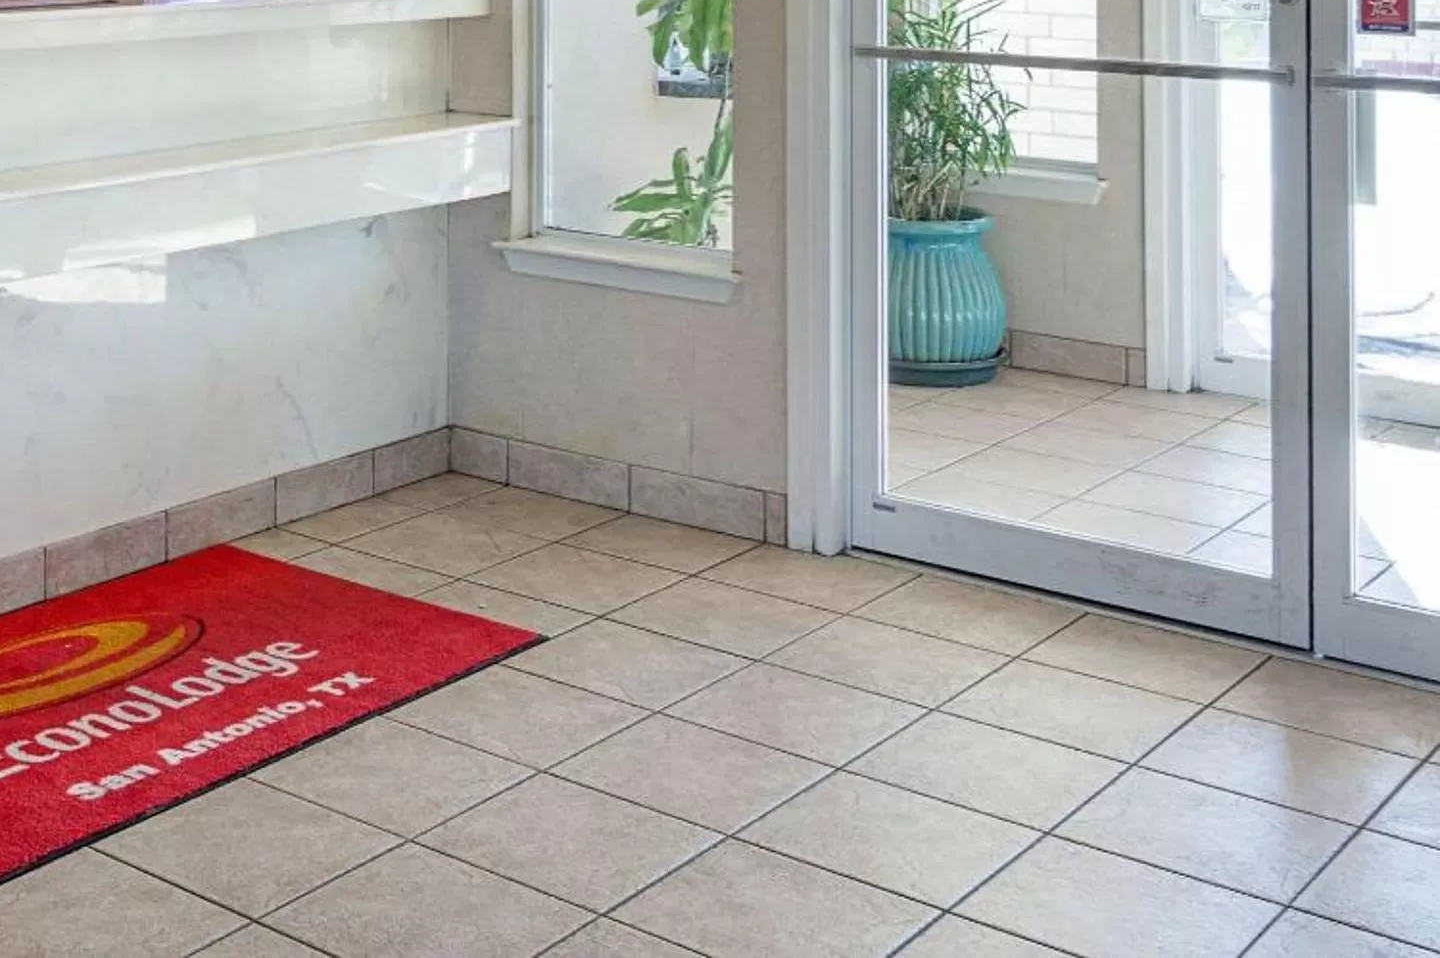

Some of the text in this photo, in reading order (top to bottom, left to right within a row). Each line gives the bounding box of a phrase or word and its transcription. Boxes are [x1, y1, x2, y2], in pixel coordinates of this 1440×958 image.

[66, 671, 376, 802] San Antonio, TX
